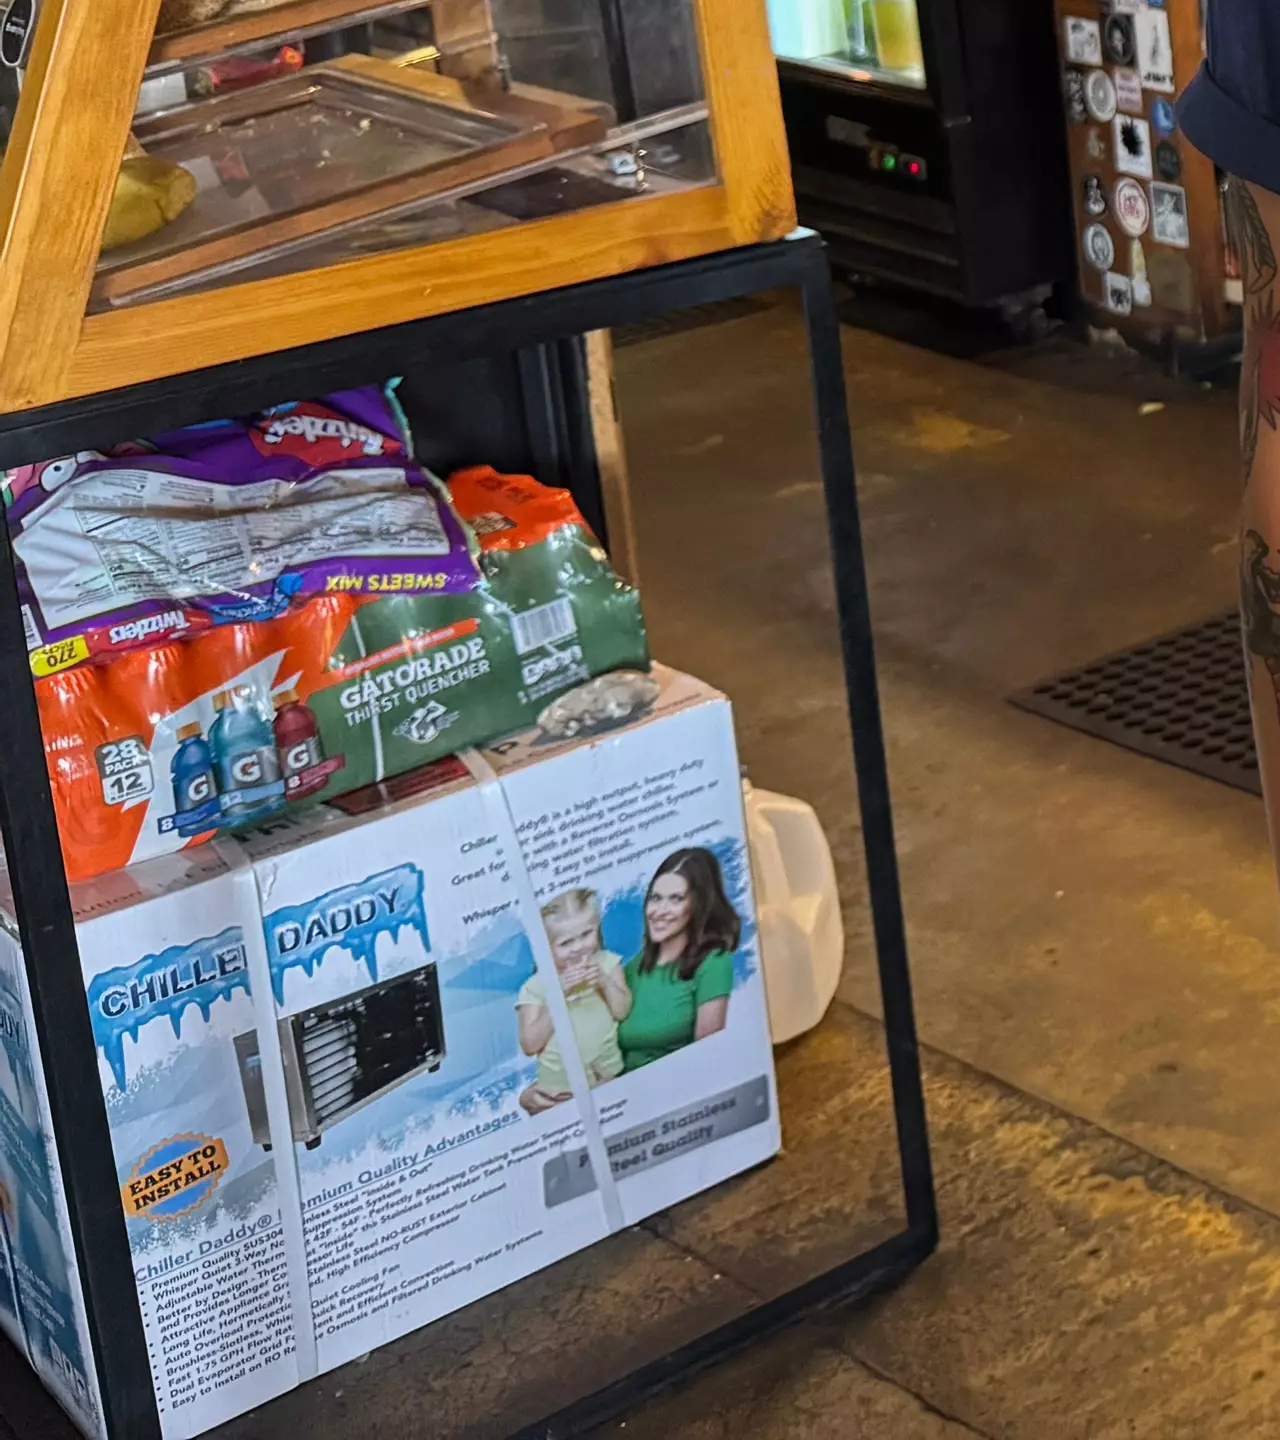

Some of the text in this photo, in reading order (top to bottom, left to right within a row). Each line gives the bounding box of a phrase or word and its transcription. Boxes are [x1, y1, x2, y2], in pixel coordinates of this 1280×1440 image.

[326, 572, 446, 591] SWEETS MIX
[110, 609, 190, 644] Twizzlers
[47, 652, 78, 667] 270
[340, 637, 486, 709] GATORADE
[344, 700, 400, 726] THIRST
[407, 659, 490, 698] QUENCHER
[101, 741, 137, 761] 28
[105, 759, 141, 776] PACK
[232, 757, 261, 782] G
[288, 744, 307, 767] G
[109, 774, 143, 792] 12
[189, 779, 208, 800] G
[574, 759, 704, 813] high output, heavy duty
[161, 819, 173, 831] 8
[452, 779, 719, 886] Great for with Reverse Osmosis System or
[532, 783, 677, 843] sink drinking water chiller.
[551, 810, 679, 865] water filtration system.
[460, 834, 498, 854] Chiller
[548, 819, 723, 894] 3-way noise suppression system.
[553, 839, 635, 877] Easy to install.
[278, 888, 399, 954] DADDY
[462, 900, 511, 925] Whisper
[652, 1124, 714, 1156] Quality
[662, 1096, 736, 1135] Stainless
[128, 1144, 216, 1196] EASY TO
[133, 1159, 221, 1210] INSTALL
[135, 1110, 519, 1282] Chiller Daddy® Quality Advantages
[151, 1267, 199, 1292] Premium
[202, 1248, 241, 1269] Quality
[243, 1228, 283, 1252] SUS304
[333, 1195, 359, 1213] Steel
[153, 1188, 402, 1302] Whisper Quiet 3-Way Suppression System
[155, 1139, 540, 1313] Adjustable Water Perfectly Refreshing Drinking Water
[157, 1303, 193, 1325] Better
[196, 1295, 208, 1310] by
[212, 1279, 249, 1302] Design
[380, 1200, 422, 1224] Stainless
[426, 1186, 450, 1205] Steel
[452, 1173, 481, 1192] Water
[484, 1162, 504, 1178] Tank
[161, 1182, 507, 1345] Attractive Appliance Stainless Steel NO-RUST Exterior Cabinet
[161, 1240, 355, 1333] and Provides Longer Life
[163, 1213, 461, 1356] Long Life, Hermetically High Efficiency Compressor
[311, 1263, 400, 1310] Quiet Cooling Fan
[168, 1280, 385, 1388] Fast 1.75 GPH Flow Recovery
[170, 1259, 456, 1398] Dual Evaporator Grid and Efficient Convection
[172, 1229, 543, 1410] Easy to Install on RO Osmosis and Filtered Drinking Water Systems
[164, 1327, 244, 1366] Auto Overload
